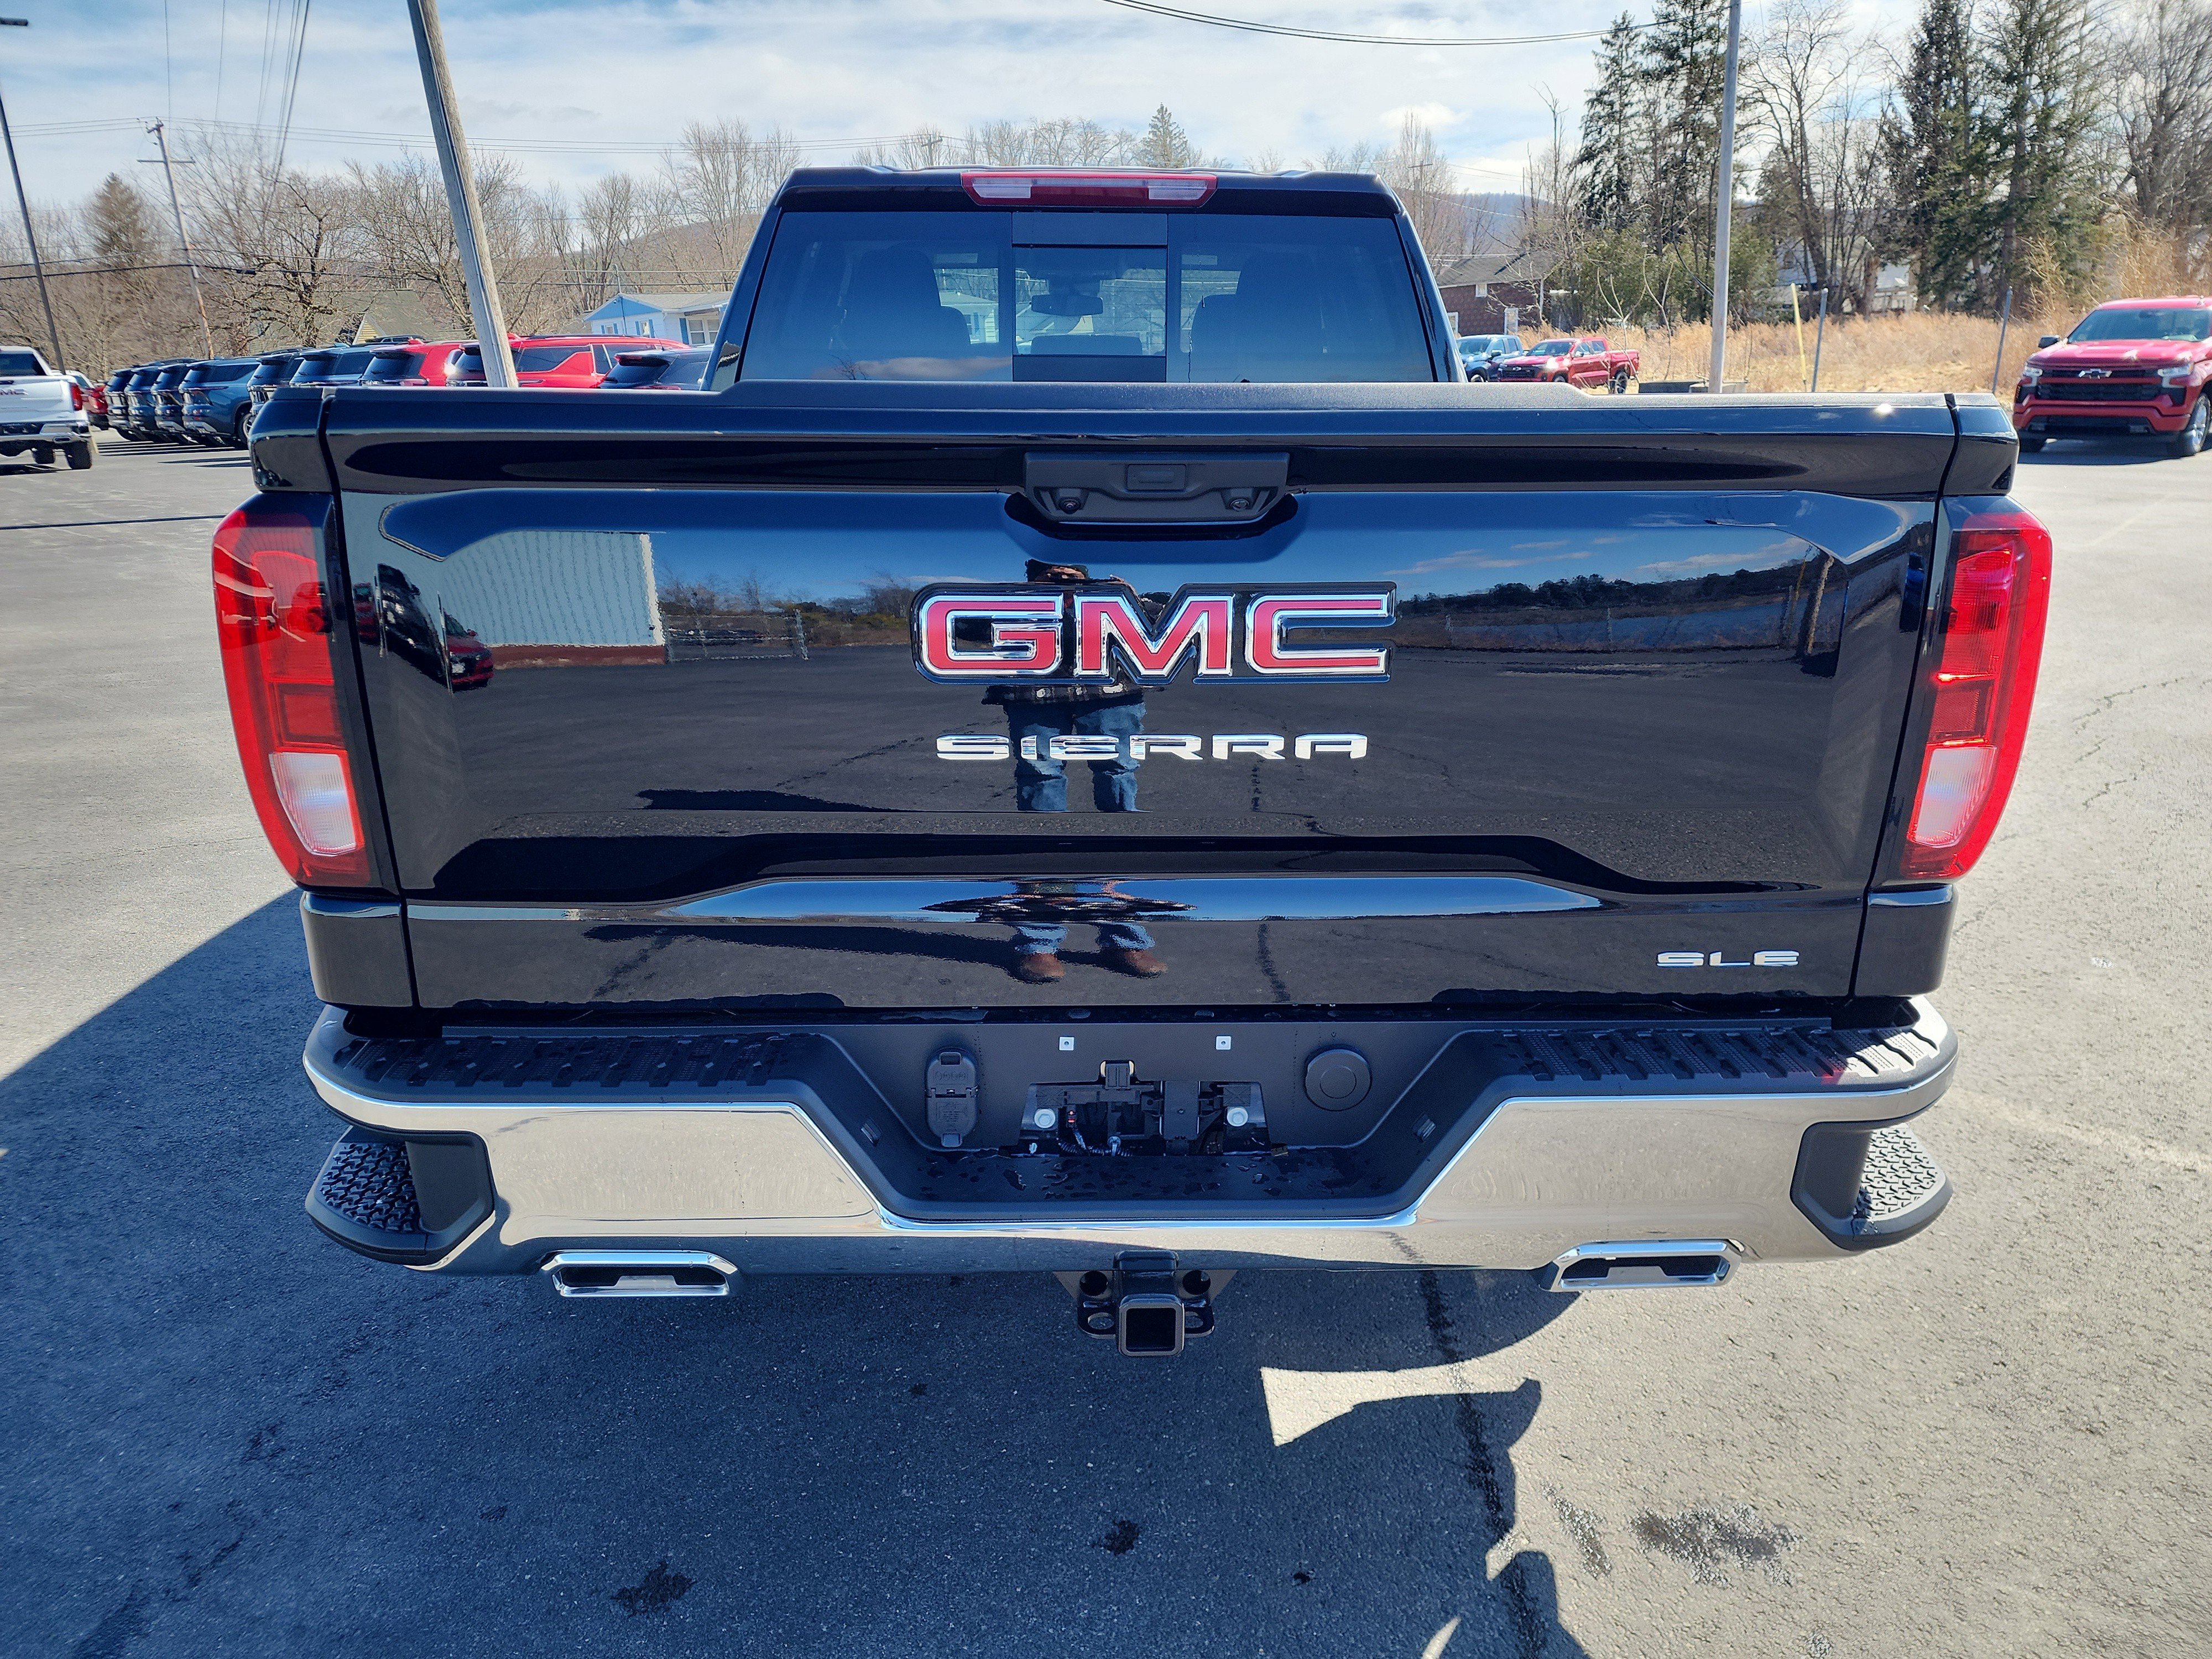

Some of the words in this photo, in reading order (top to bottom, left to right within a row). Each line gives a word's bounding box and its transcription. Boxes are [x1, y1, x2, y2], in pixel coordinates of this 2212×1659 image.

[915, 587, 1394, 681] GMC
[936, 733, 1368, 761] SIERRA
[1656, 950, 1799, 967] SLE
